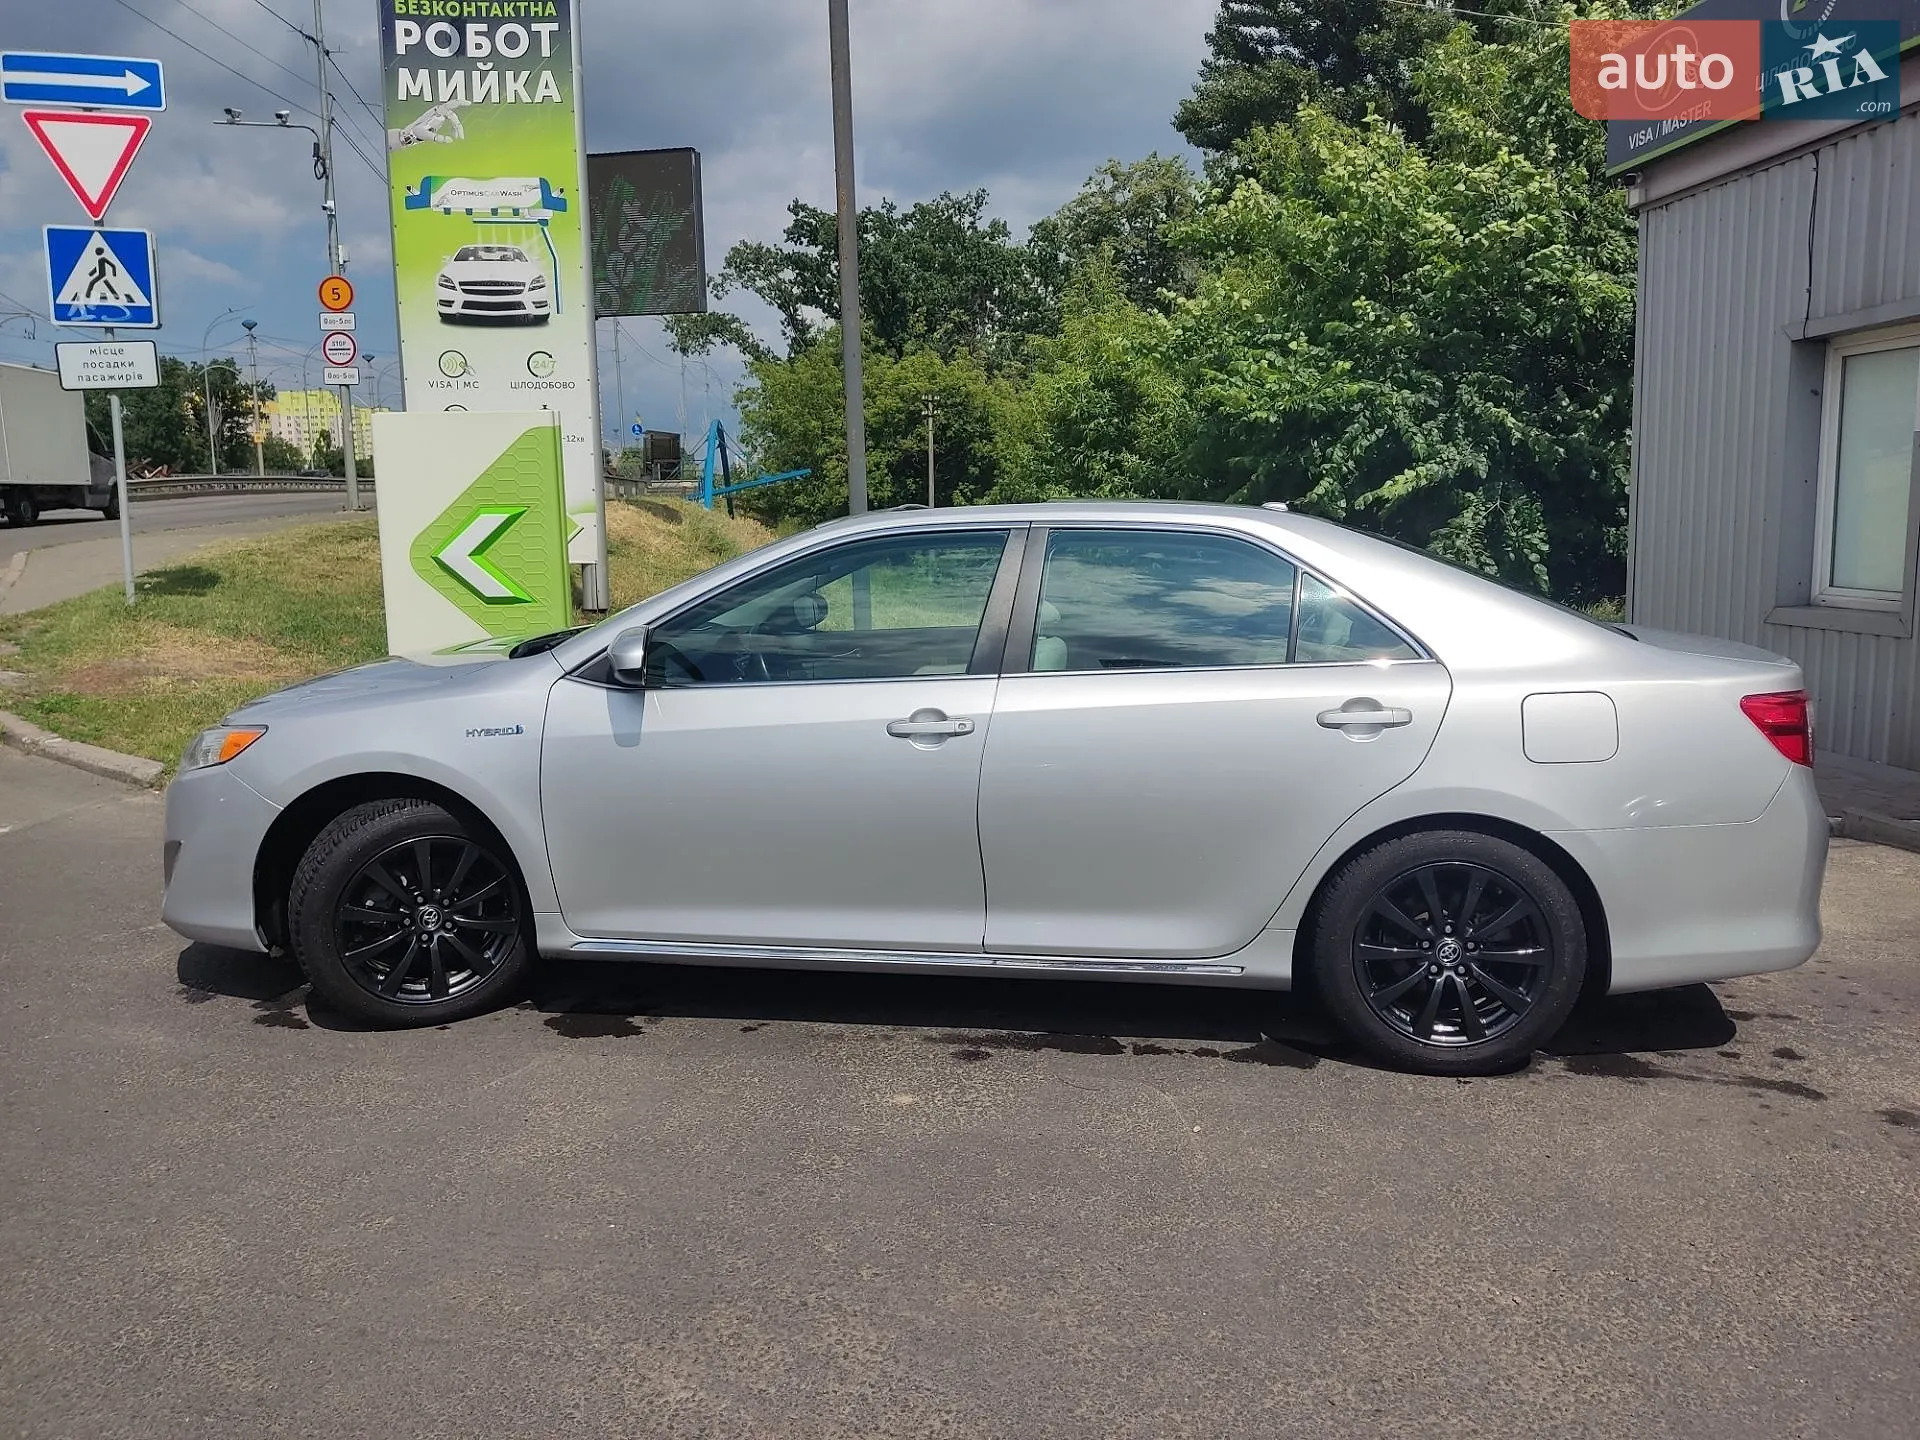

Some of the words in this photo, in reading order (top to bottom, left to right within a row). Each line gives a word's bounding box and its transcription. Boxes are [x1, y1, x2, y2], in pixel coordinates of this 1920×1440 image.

[394, 0, 558, 17] БЕЗКОНТАКТНА
[394, 19, 560, 59] РОБОТ
[397, 61, 563, 104] МИЙКА
[1628, 127, 1654, 150] VISA
[1661, 100, 1712, 136] MASTER
[331, 287, 341, 301] 5
[89, 346, 124, 356] місце
[83, 360, 135, 369] посадки
[533, 360, 556, 370] 24/7
[77, 373, 143, 382] пасажирів
[428, 380, 453, 389] VISA
[510, 381, 576, 390] ЦІЛОДОБОВО
[465, 727, 515, 738] HYBRID
